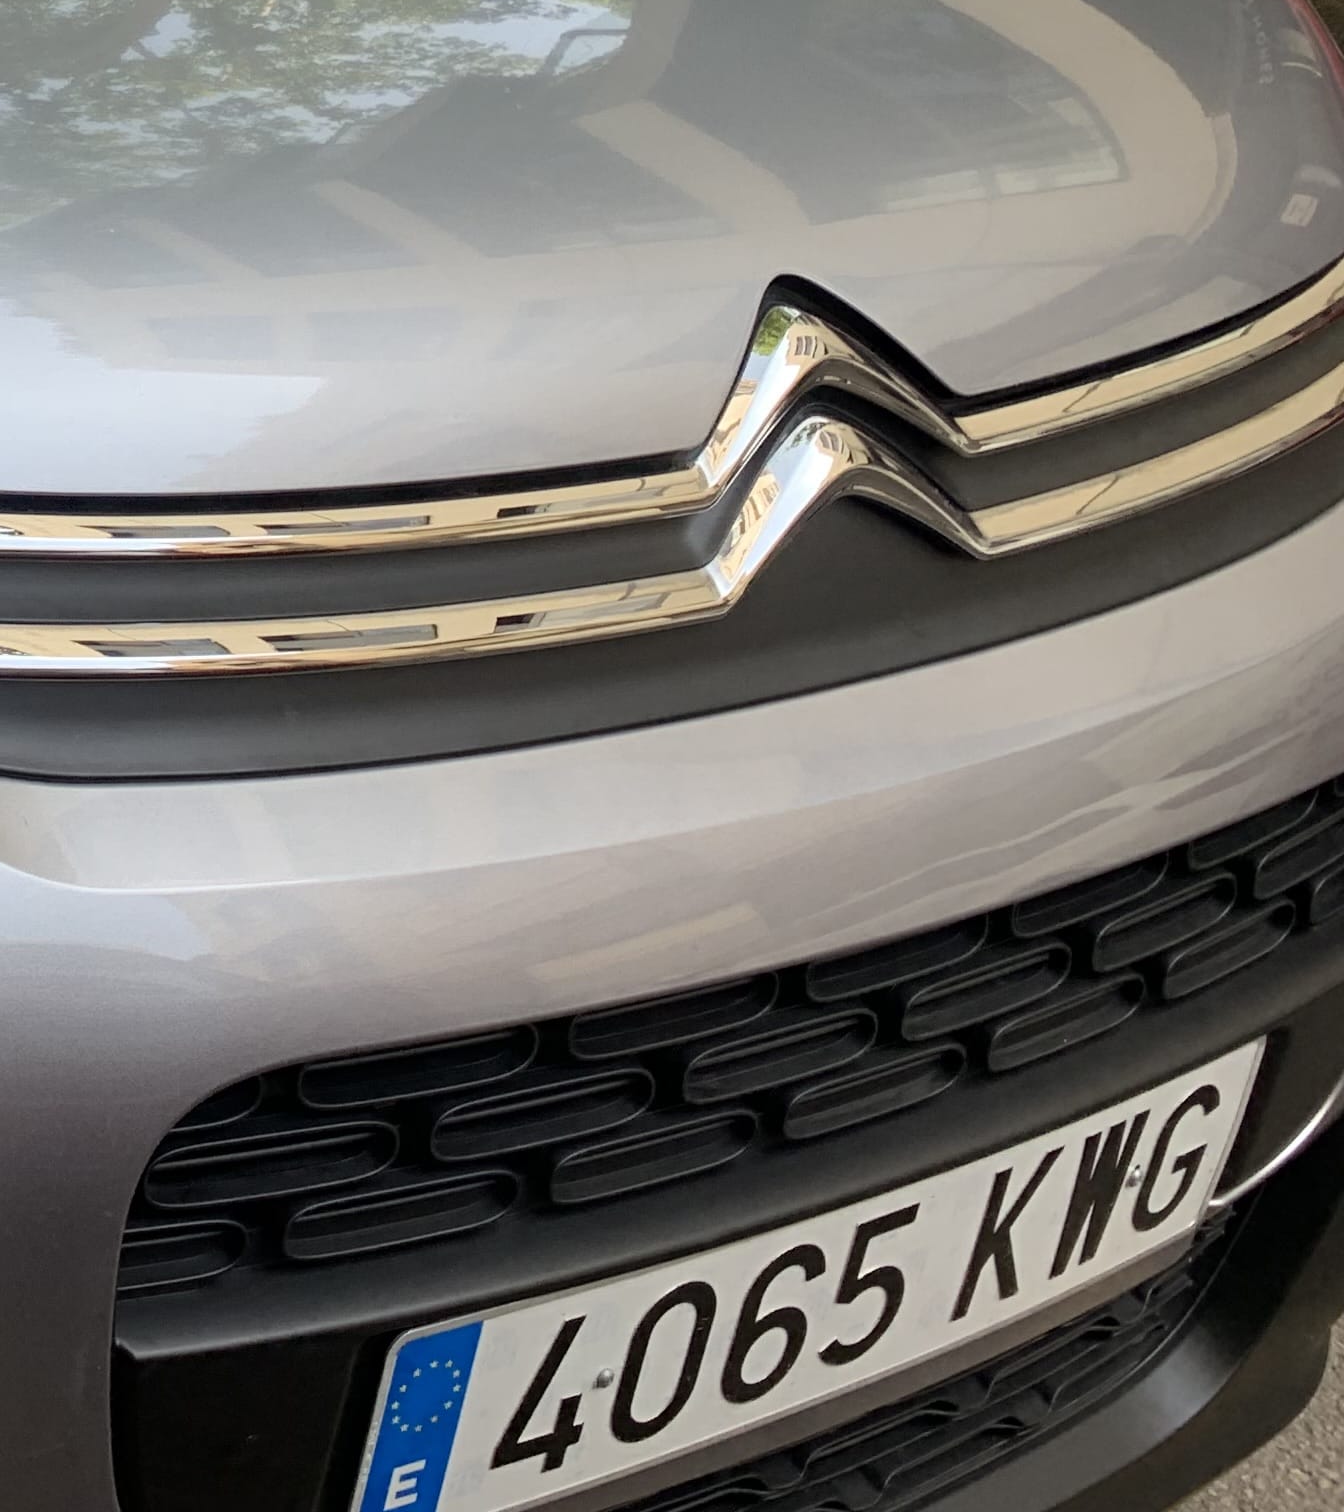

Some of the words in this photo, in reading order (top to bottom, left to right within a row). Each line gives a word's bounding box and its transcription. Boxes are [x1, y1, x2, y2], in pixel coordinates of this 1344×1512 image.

[489, 1202, 920, 1473] 4065
[949, 1083, 1220, 1322] KWG
[383, 1458, 426, 1509] E
